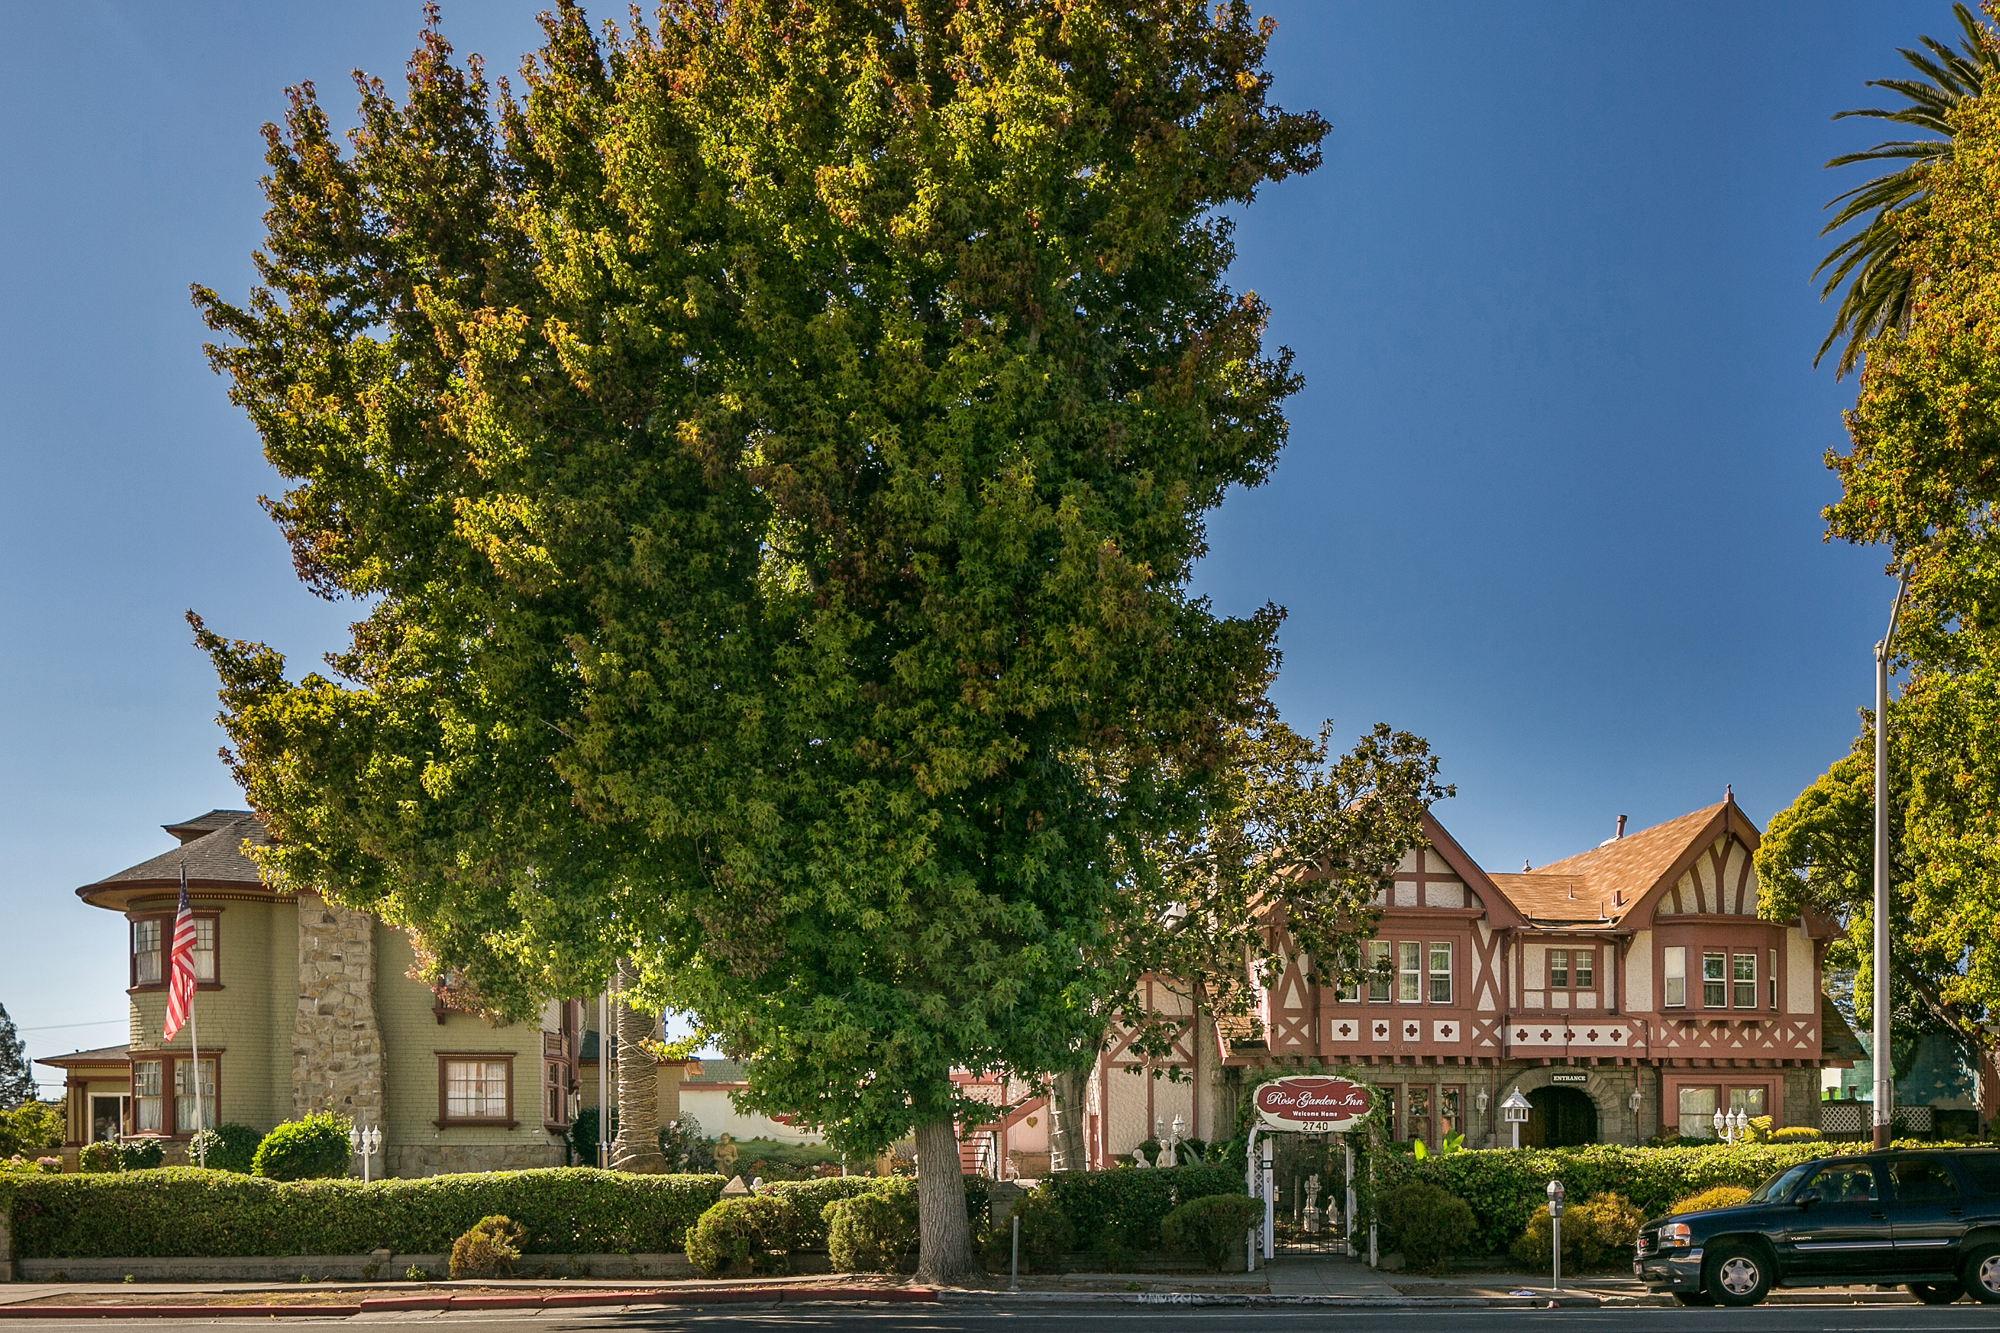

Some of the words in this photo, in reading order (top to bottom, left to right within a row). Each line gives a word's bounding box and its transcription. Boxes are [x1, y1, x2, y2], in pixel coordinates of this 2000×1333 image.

[1384, 1045, 1413, 1053] 2740
[1266, 1091, 1295, 1105] Rose
[1296, 1091, 1337, 1108] Garden
[1338, 1092, 1364, 1106] Inn
[1302, 1121, 1329, 1131] 2740
